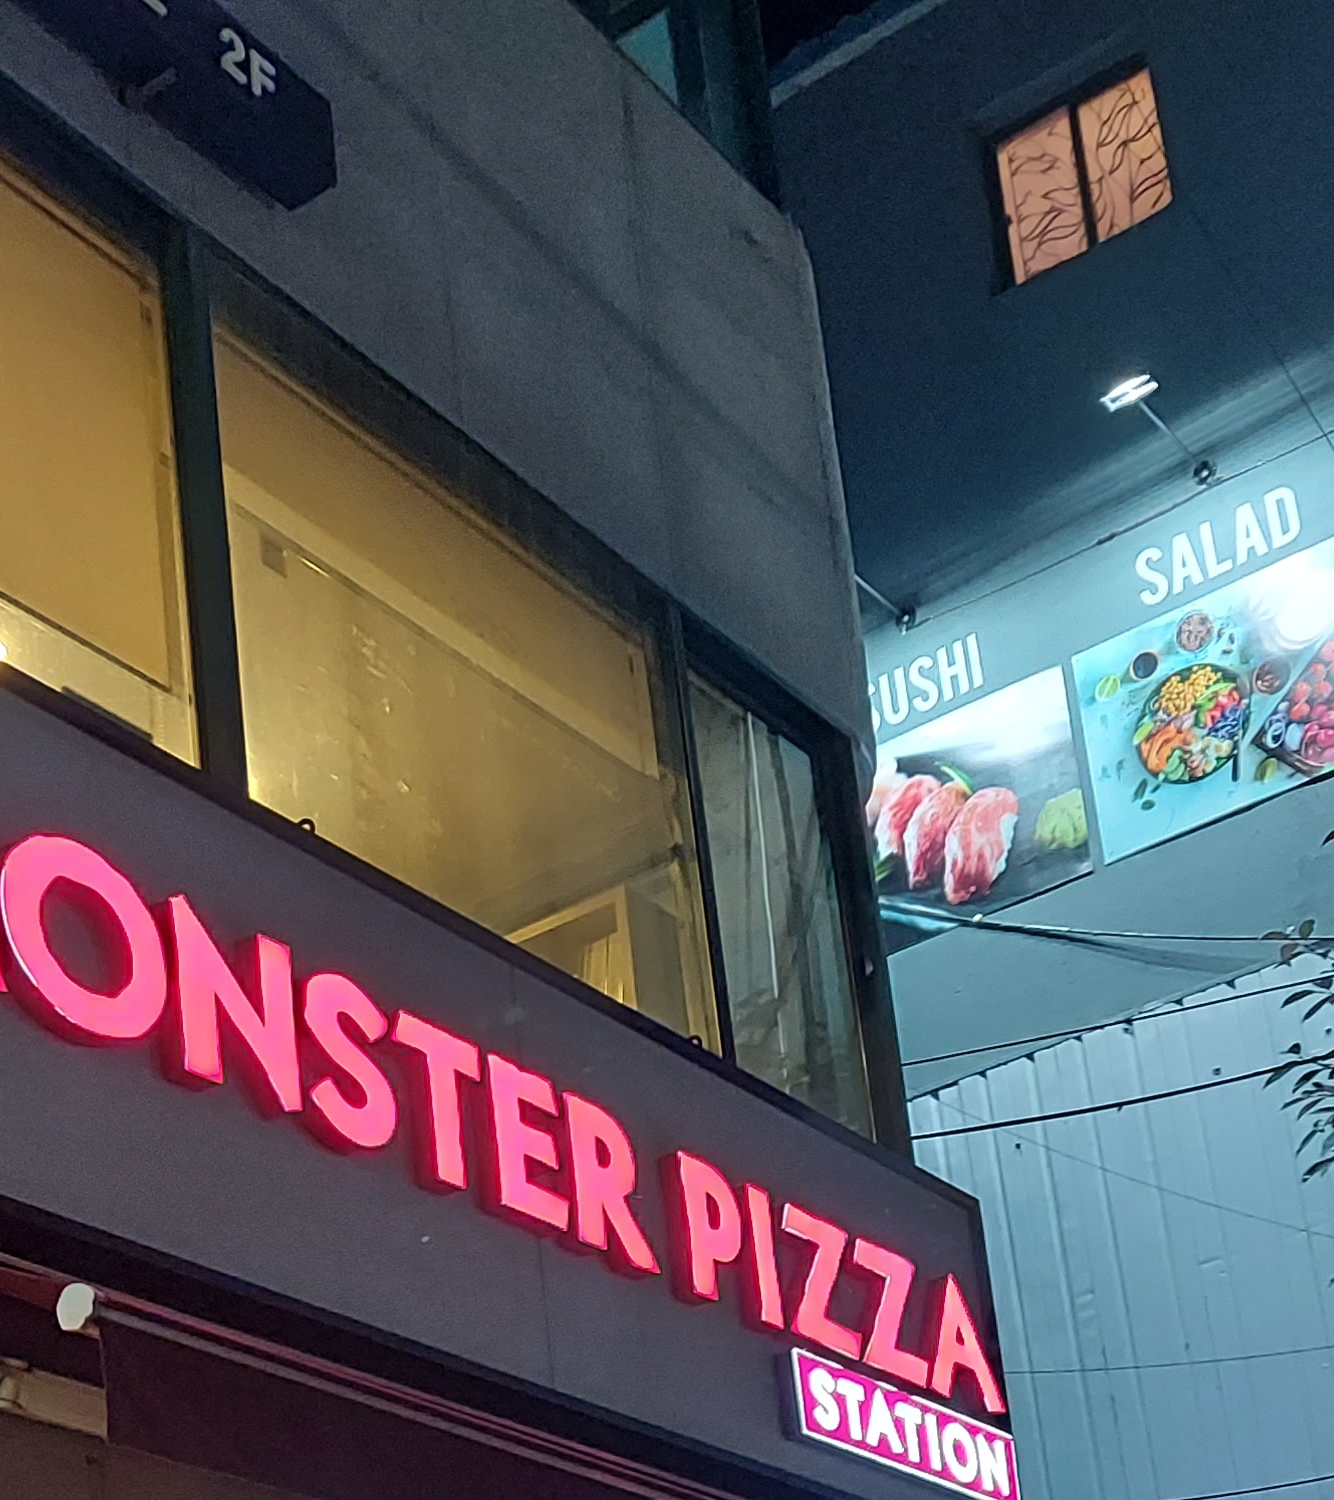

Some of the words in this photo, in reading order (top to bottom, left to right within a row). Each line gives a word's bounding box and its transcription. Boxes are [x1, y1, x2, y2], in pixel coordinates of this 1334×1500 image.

[218, 27, 277, 97] 2F
[1134, 485, 1304, 606] SALAD
[677, 1150, 1007, 1414] PIZZA
[807, 1366, 1010, 1497] STATION
